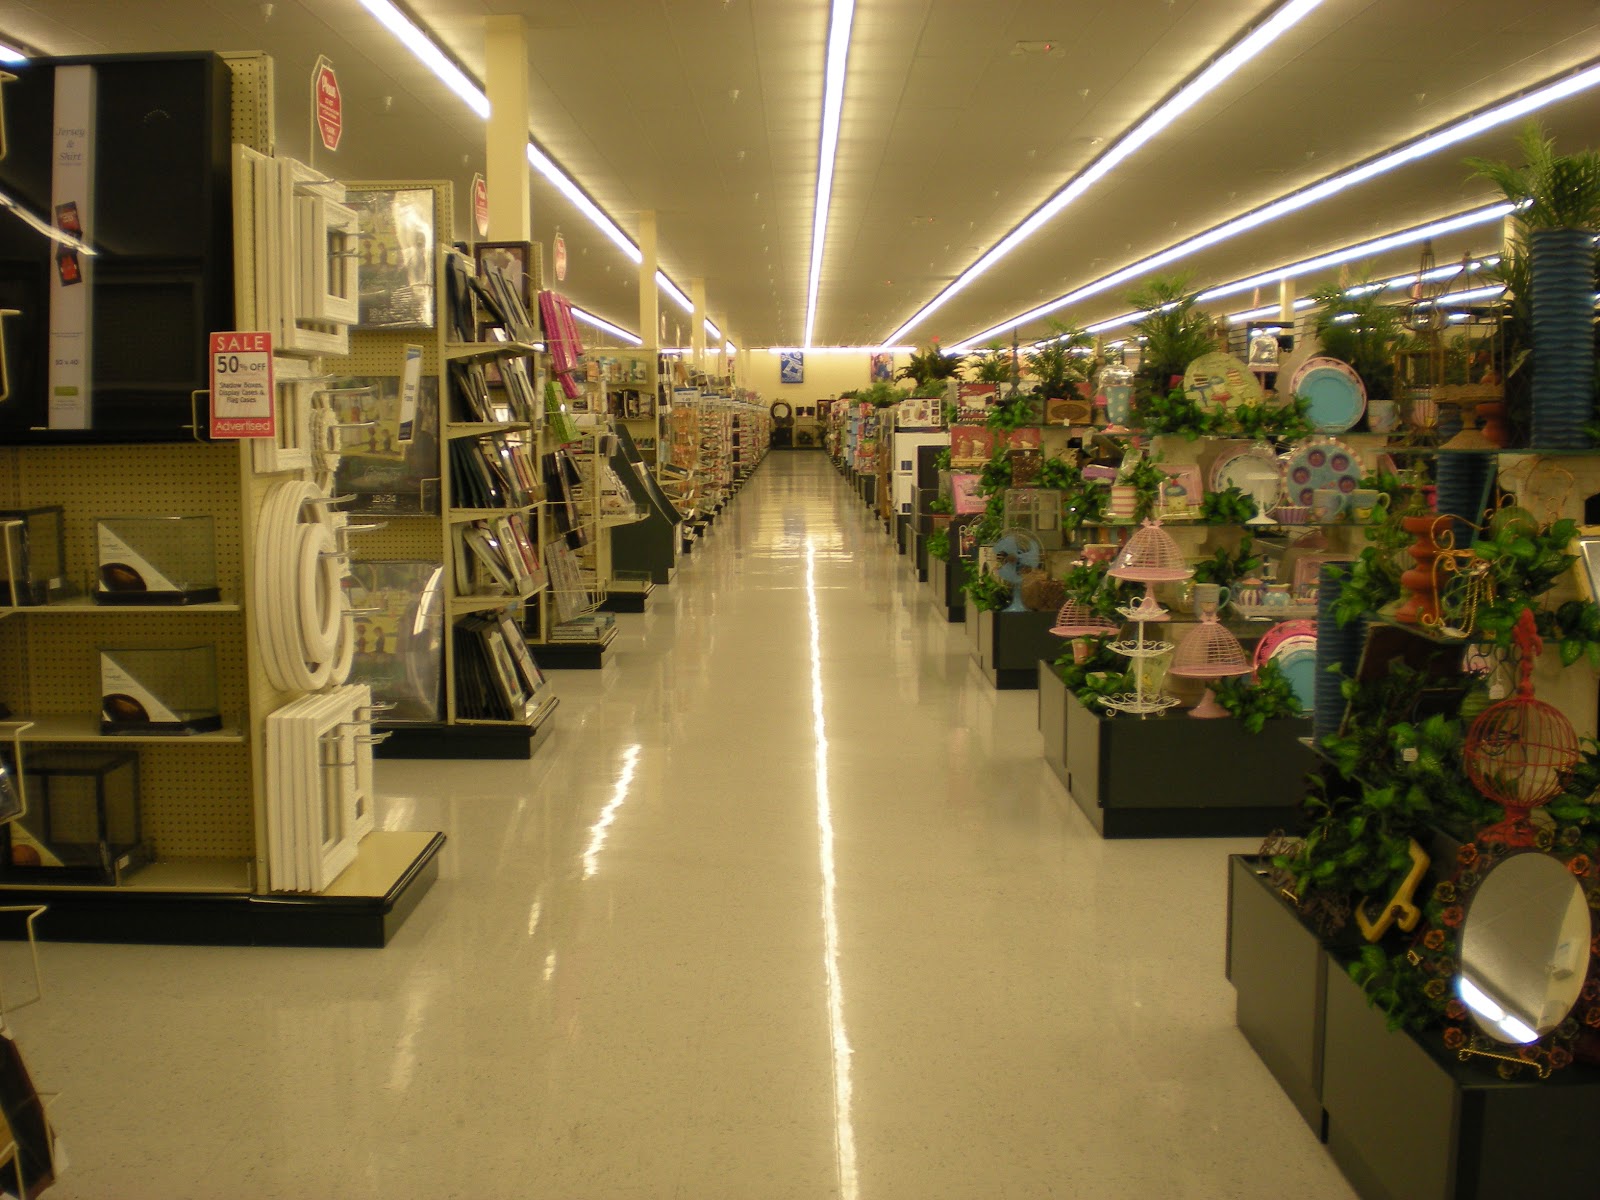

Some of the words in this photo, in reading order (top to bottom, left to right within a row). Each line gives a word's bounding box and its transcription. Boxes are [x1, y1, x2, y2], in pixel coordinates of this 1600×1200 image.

[56, 128, 85, 138] Jersey
[60, 152, 82, 161] Shirt
[216, 335, 264, 351] SALE
[217, 355, 248, 374] 50%
[249, 362, 266, 372] OFF
[219, 381, 242, 389] Shadow
[218, 389, 240, 397] Display
[226, 396, 239, 404] Flag
[215, 421, 270, 431] Advertised
